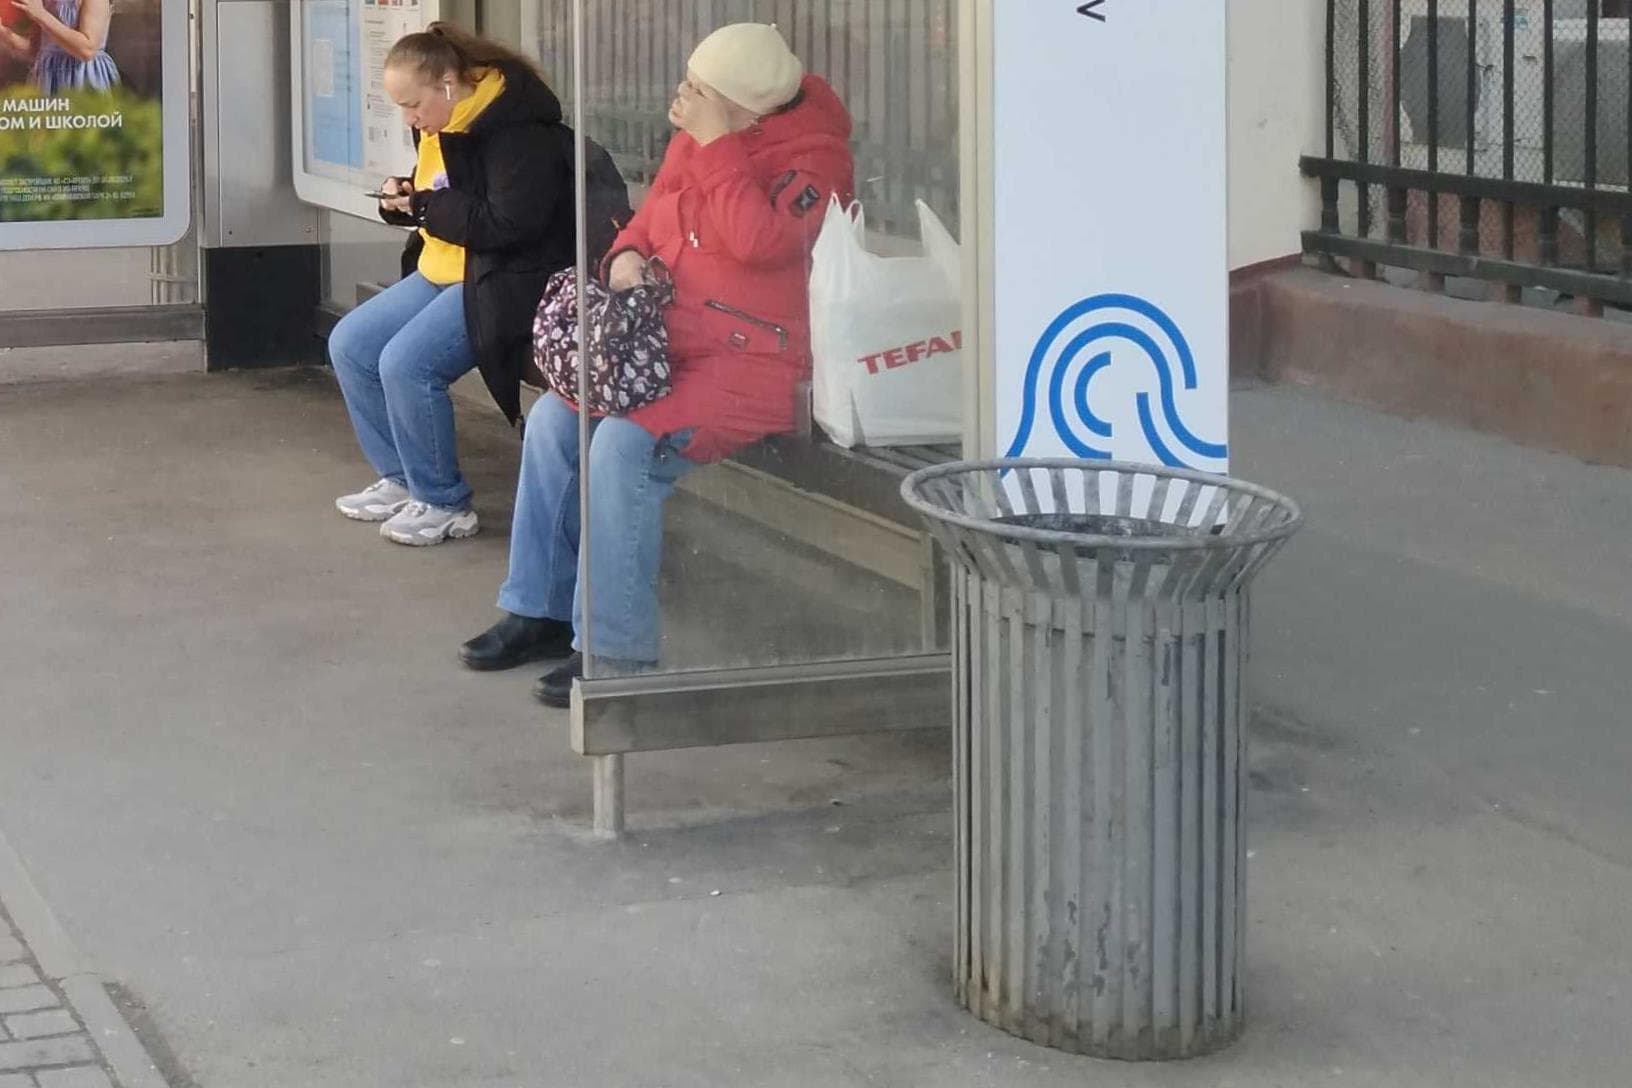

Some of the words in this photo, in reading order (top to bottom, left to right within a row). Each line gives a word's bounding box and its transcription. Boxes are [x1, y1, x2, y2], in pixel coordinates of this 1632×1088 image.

[2, 98, 70, 112] МАШИН
[29, 116, 42, 130] И
[46, 110, 123, 130] ШКОЛОЙ
